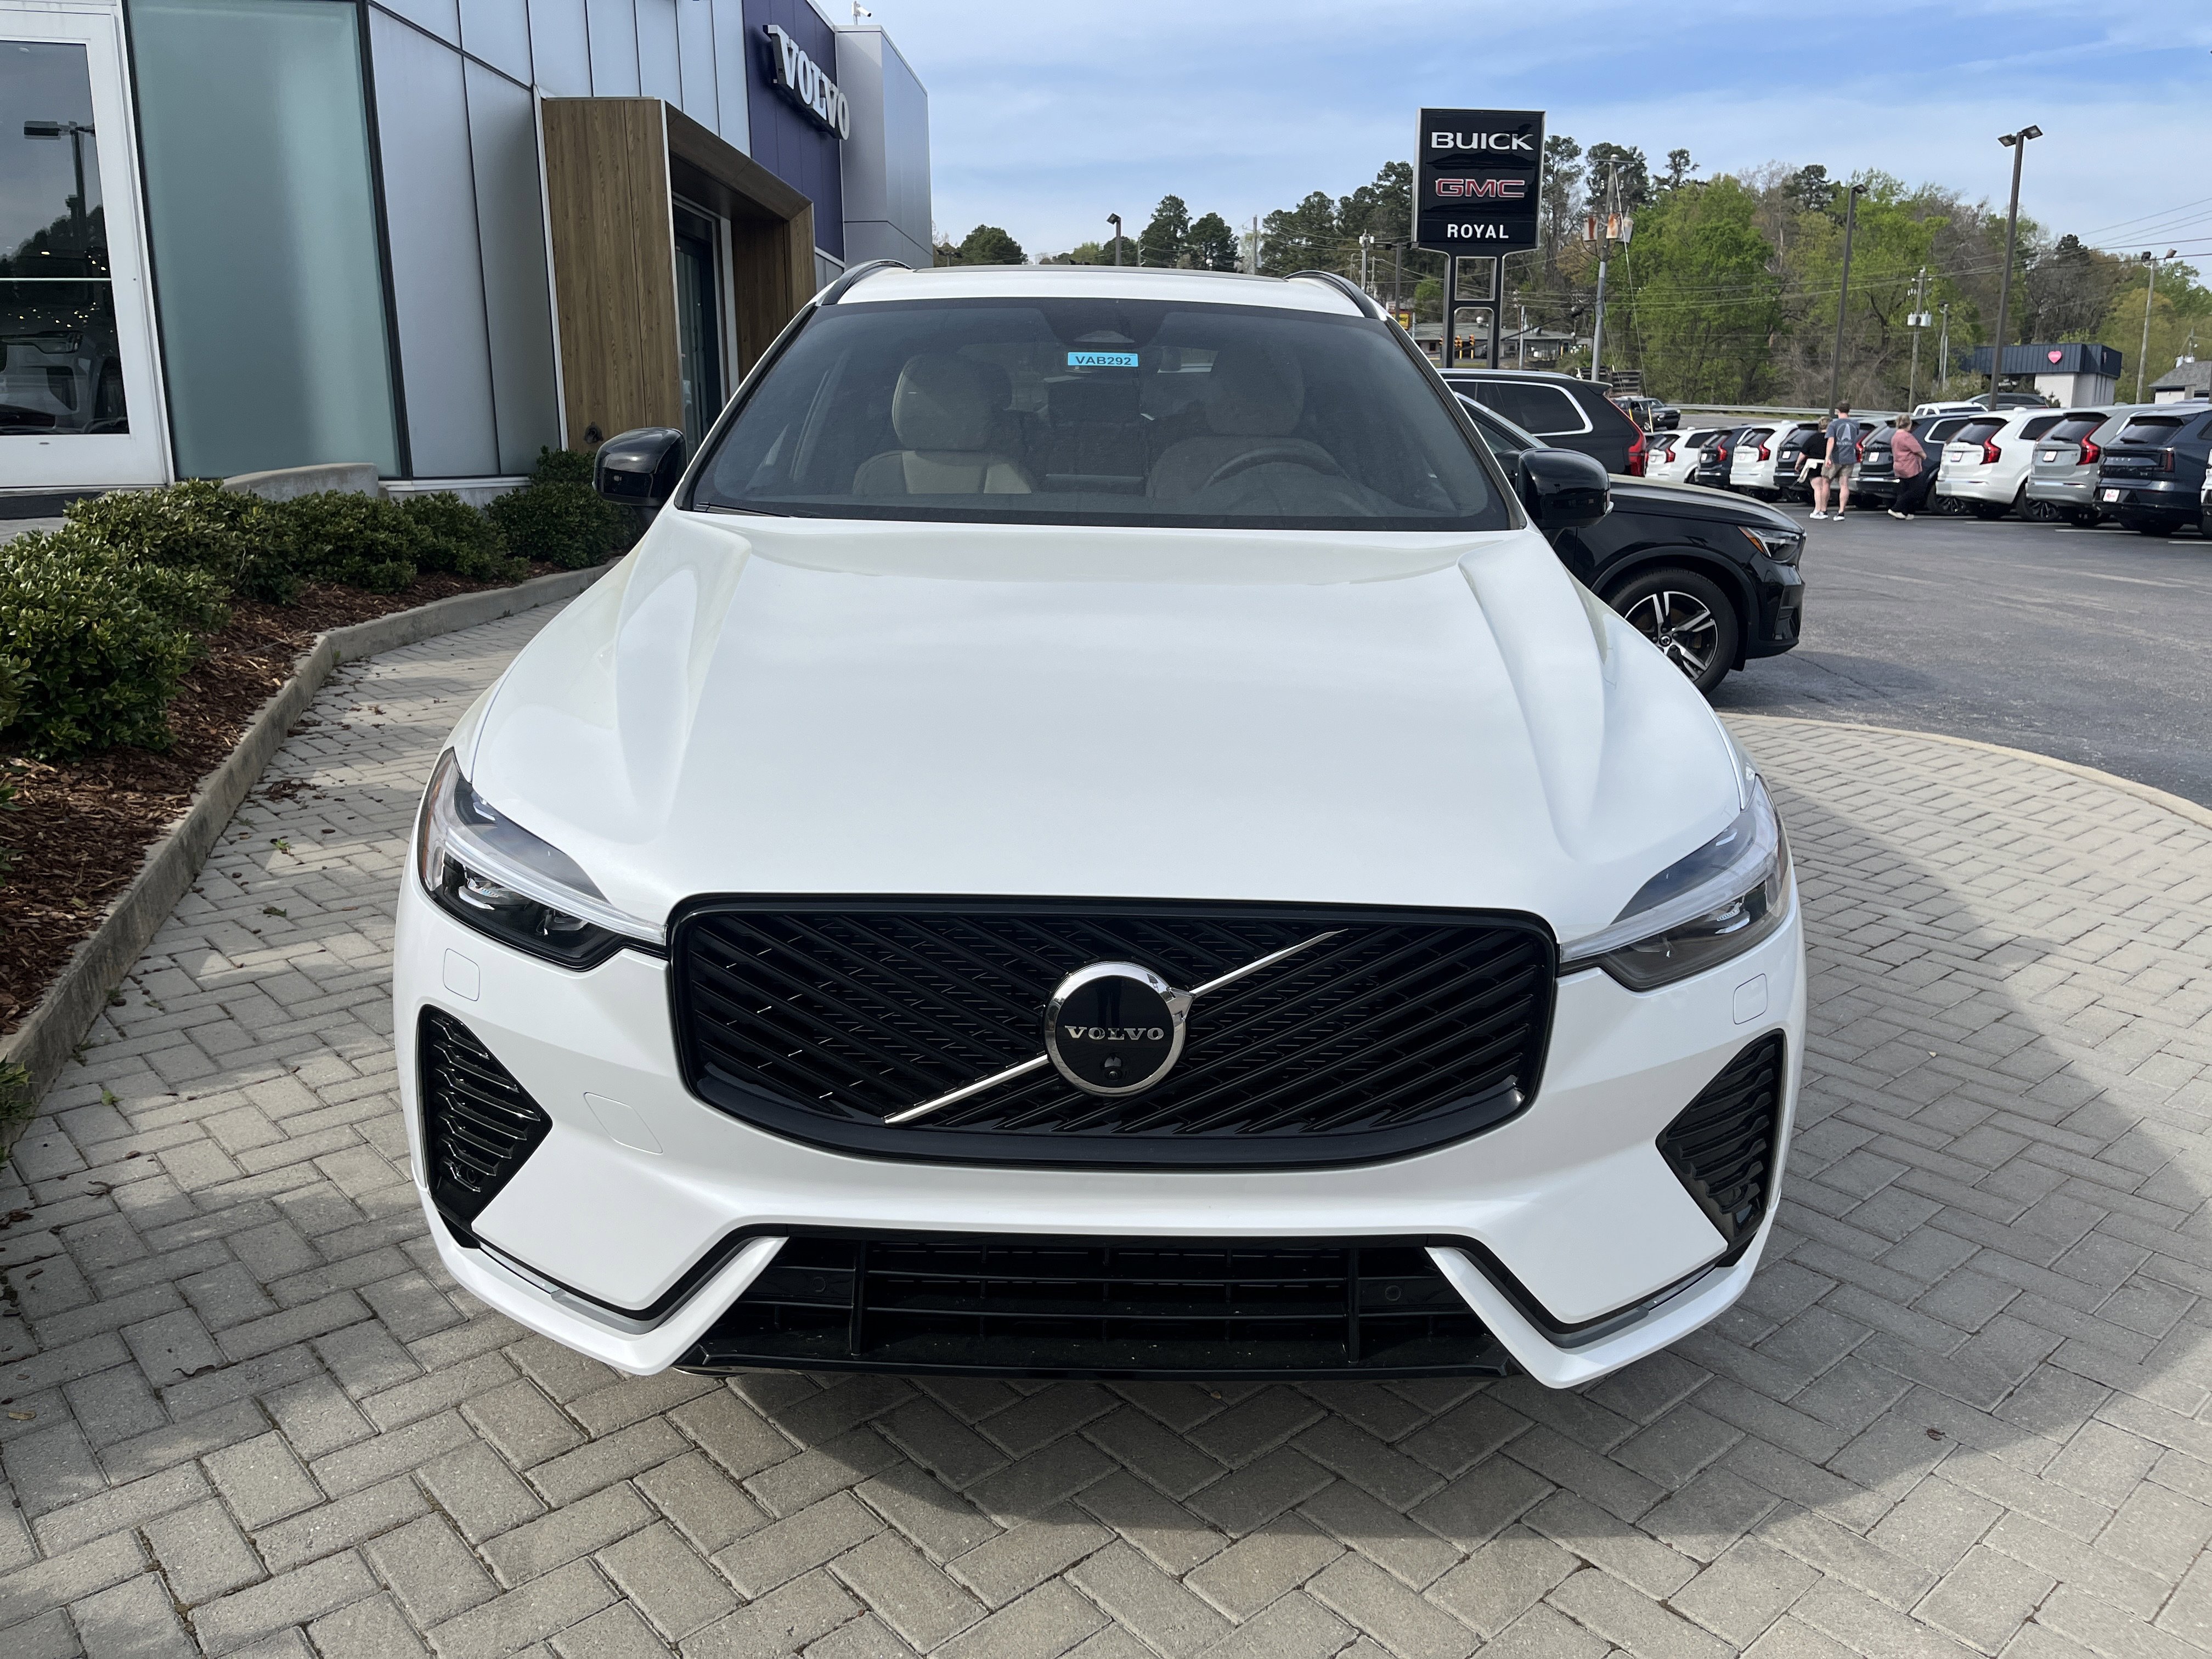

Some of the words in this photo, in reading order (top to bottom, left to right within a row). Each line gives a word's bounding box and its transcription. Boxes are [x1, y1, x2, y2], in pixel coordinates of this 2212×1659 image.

[767, 25, 850, 140] VOLVO
[1431, 132, 1534, 150] BUICK
[1435, 178, 1525, 198] GMC
[1447, 223, 1509, 239] ROYAL
[1075, 356, 1132, 365] VAB292
[1064, 1025, 1164, 1040] VOLVO
